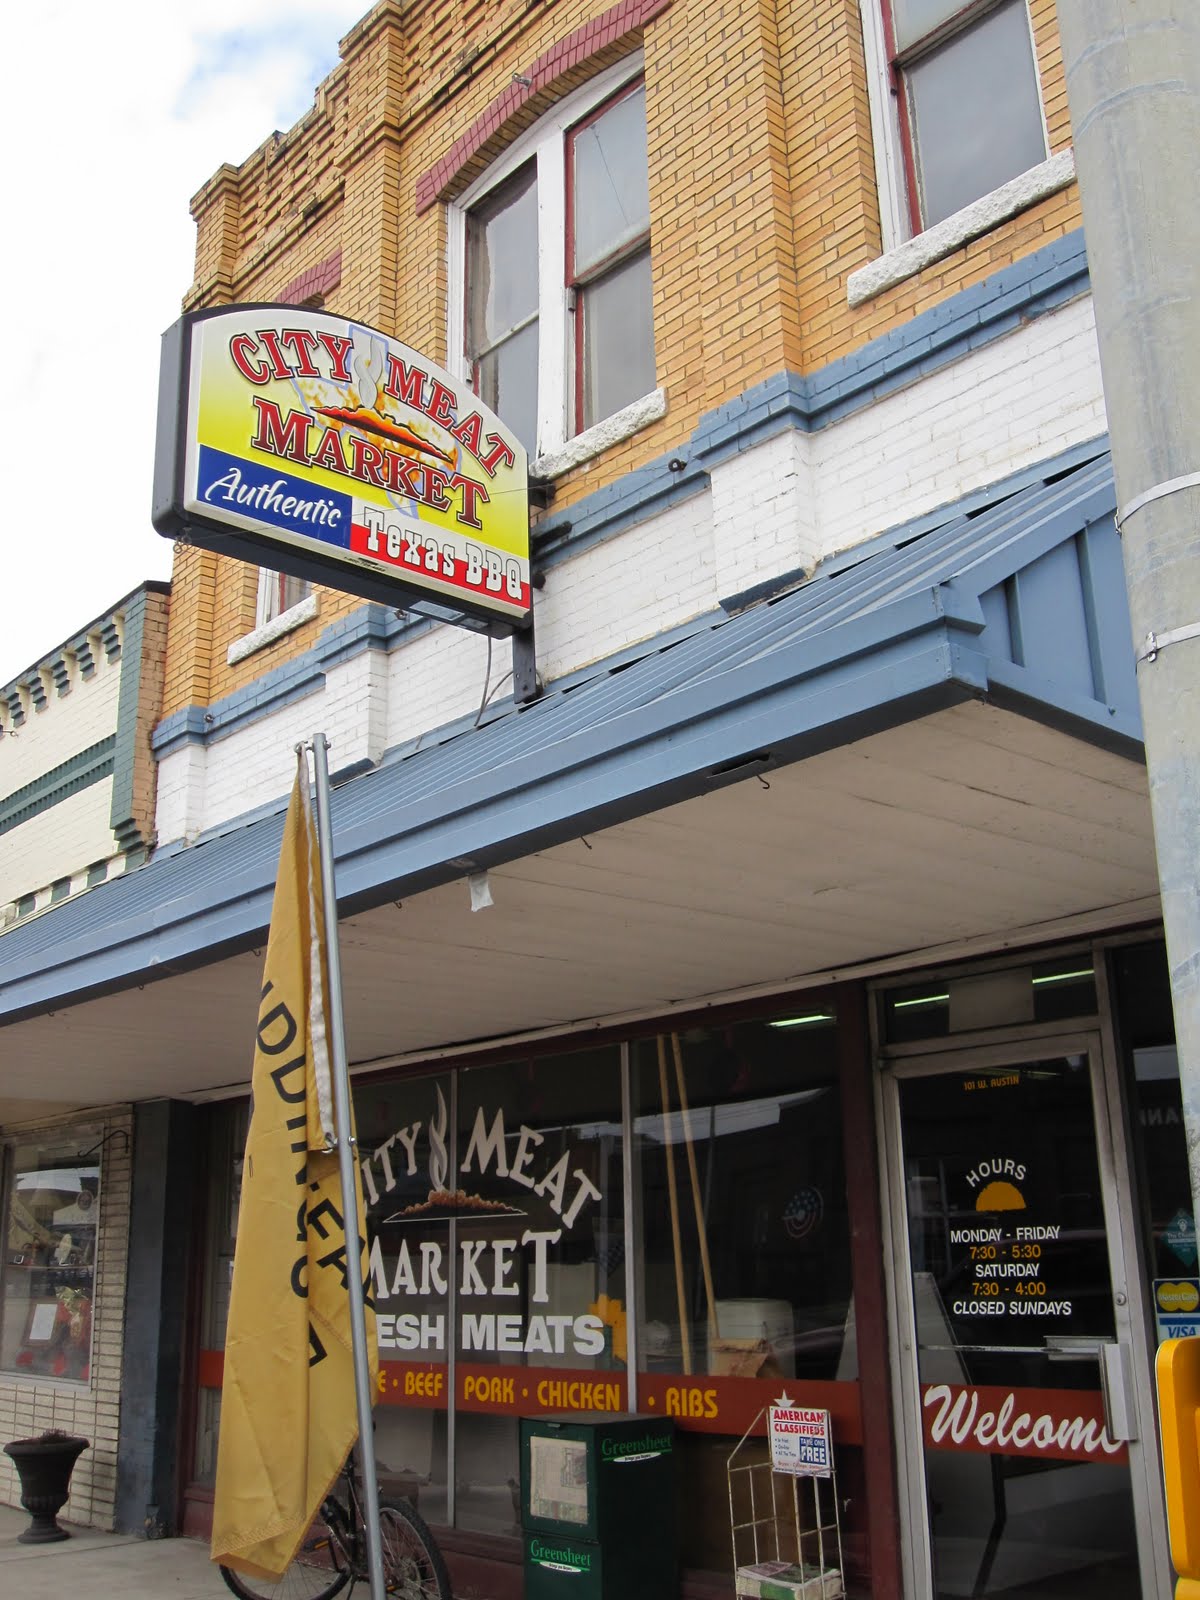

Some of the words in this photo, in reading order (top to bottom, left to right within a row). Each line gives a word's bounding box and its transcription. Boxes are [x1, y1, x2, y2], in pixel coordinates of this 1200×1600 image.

[229, 328, 354, 386] CITY
[385, 352, 516, 479] MEAT
[250, 396, 491, 530] MARKET
[204, 467, 342, 528] Authentic
[363, 506, 456, 578] Texas
[466, 543, 523, 601] BBQ
[963, 1081, 976, 1092] 101
[990, 1075, 1020, 1088] AUSTIN
[361, 1121, 422, 1206] ITY
[460, 1106, 602, 1229] MEAT
[965, 1158, 1027, 1188] HOURS
[950, 1228, 1002, 1244] MONDAY
[1016, 1226, 1061, 1241] FRIDAY
[969, 1246, 997, 1260] 7:30
[1012, 1245, 1042, 1259] 5:30
[369, 1229, 562, 1303] MARKET
[975, 1263, 1040, 1278] SATURDAY
[972, 1282, 999, 1296] 7:30
[1015, 1281, 1046, 1296] 4:00
[953, 1301, 1005, 1316] CLOSED
[1009, 1300, 1072, 1316] SUNDAYS
[376, 1313, 445, 1350] ESH
[461, 1314, 605, 1356] MEATS
[1168, 1326, 1197, 1339] VISA
[404, 1372, 443, 1398] BEEF
[464, 1375, 514, 1404] PORK
[537, 1380, 621, 1412] CHICKEN
[666, 1387, 719, 1419] RIBS
[773, 1409, 825, 1423] AMERICAN
[774, 1423, 825, 1436] CLASSIFIEDS
[601, 1434, 673, 1456] Greensheet
[801, 1446, 826, 1463] FREE
[530, 1539, 591, 1567] Greensheet
